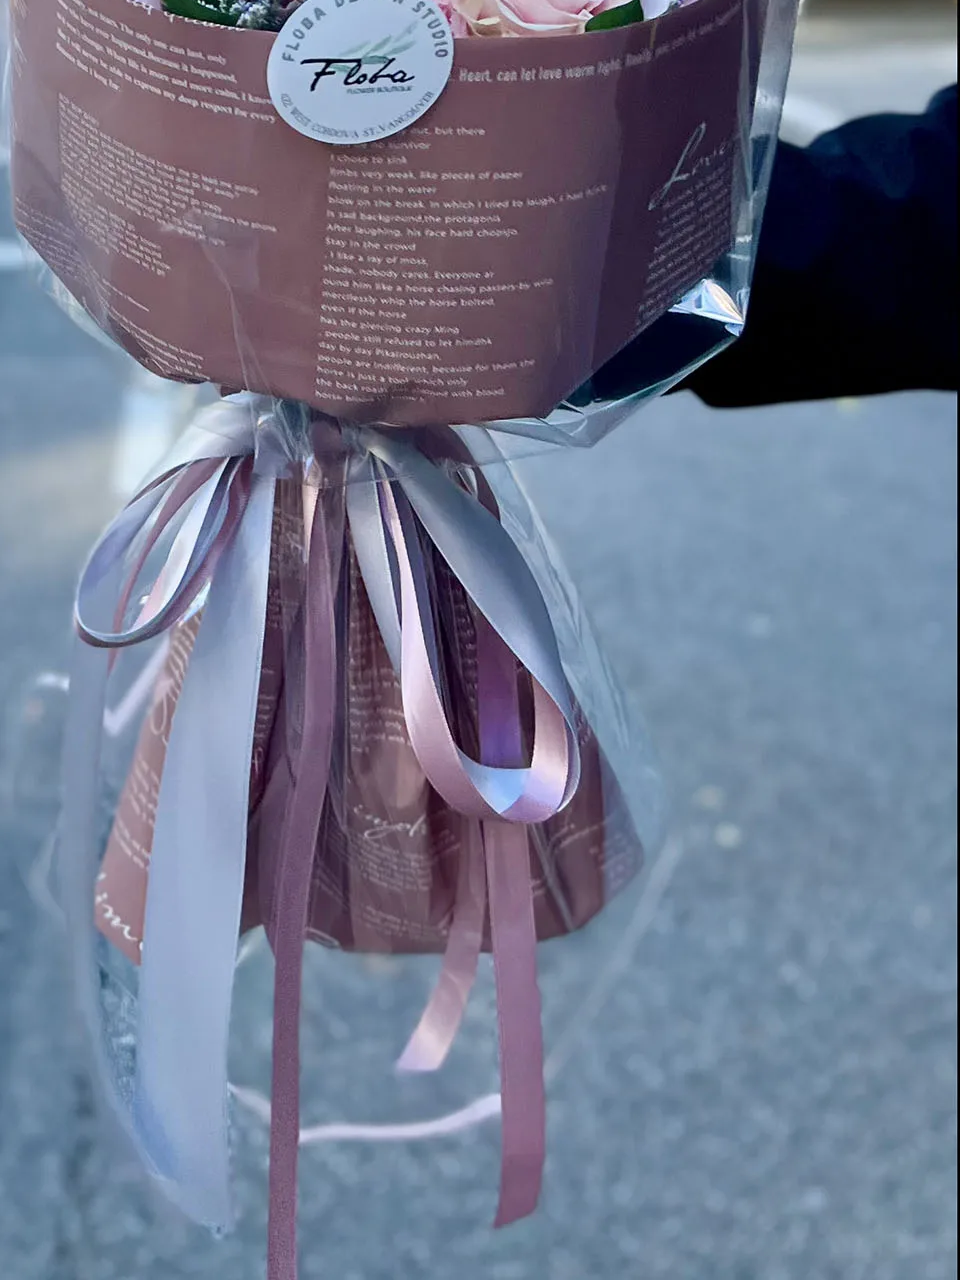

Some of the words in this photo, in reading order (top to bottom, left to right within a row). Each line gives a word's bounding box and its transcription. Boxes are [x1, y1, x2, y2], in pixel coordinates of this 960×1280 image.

[281, 7, 327, 62] FLOBA
[412, 0, 449, 58] STUDIO
[300, 57, 415, 92] Floba
[496, 71, 518, 82] can
[520, 66, 536, 81] let
[178, 94, 199, 108] deep
[200, 101, 232, 115] respect
[249, 112, 275, 124] every
[435, 126, 453, 135] but
[456, 127, 486, 136] there
[371, 156, 384, 164] to
[360, 170, 383, 180] very
[419, 170, 439, 180] like
[441, 171, 475, 181] pieces
[478, 171, 490, 180] of
[492, 171, 524, 181] paper
[386, 185, 405, 194] the
[407, 185, 437, 194] water
[356, 199, 371, 207] on
[373, 199, 392, 208] the
[442, 199, 475, 209] which
[484, 199, 509, 209] tried
[511, 200, 524, 208] to
[339, 211, 357, 220] sad
[326, 223, 352, 233] After
[406, 227, 422, 237] his
[424, 227, 447, 237] face
[450, 228, 474, 238] hard
[325, 236, 346, 248] Stay
[349, 239, 360, 248] in
[362, 240, 381, 250] the
[384, 242, 416, 252] crowd
[336, 251, 356, 260] like
[367, 256, 383, 265] ray
[385, 255, 399, 264] of
[359, 268, 397, 280] nobody
[434, 270, 481, 280] Everyone
[352, 280, 372, 289] him
[374, 282, 393, 291] like
[405, 284, 434, 293] horse
[437, 284, 476, 294] chasing
[380, 297, 406, 307] whip
[408, 297, 426, 307] the
[428, 298, 457, 307] horse
[320, 304, 345, 313] even
[357, 307, 375, 317] the
[378, 309, 407, 319] horse
[320, 315, 338, 326] has
[340, 319, 358, 328] the
[359, 321, 402, 333] piercing
[405, 326, 432, 336] crazy
[325, 330, 360, 342] people
[362, 335, 381, 344] still
[384, 336, 422, 347] refused
[424, 339, 436, 347] to
[439, 338, 453, 348] let
[318, 340, 336, 352] day
[339, 344, 352, 354] by
[354, 347, 372, 356] day
[317, 353, 352, 366] people
[355, 360, 371, 369] are
[432, 364, 472, 374] because
[475, 363, 489, 372] for
[492, 362, 518, 371] them
[316, 365, 344, 376] horse
[357, 372, 377, 382] just
[446, 377, 468, 387] only
[316, 377, 333, 387] the
[336, 380, 358, 391] back
[451, 388, 473, 398] with
